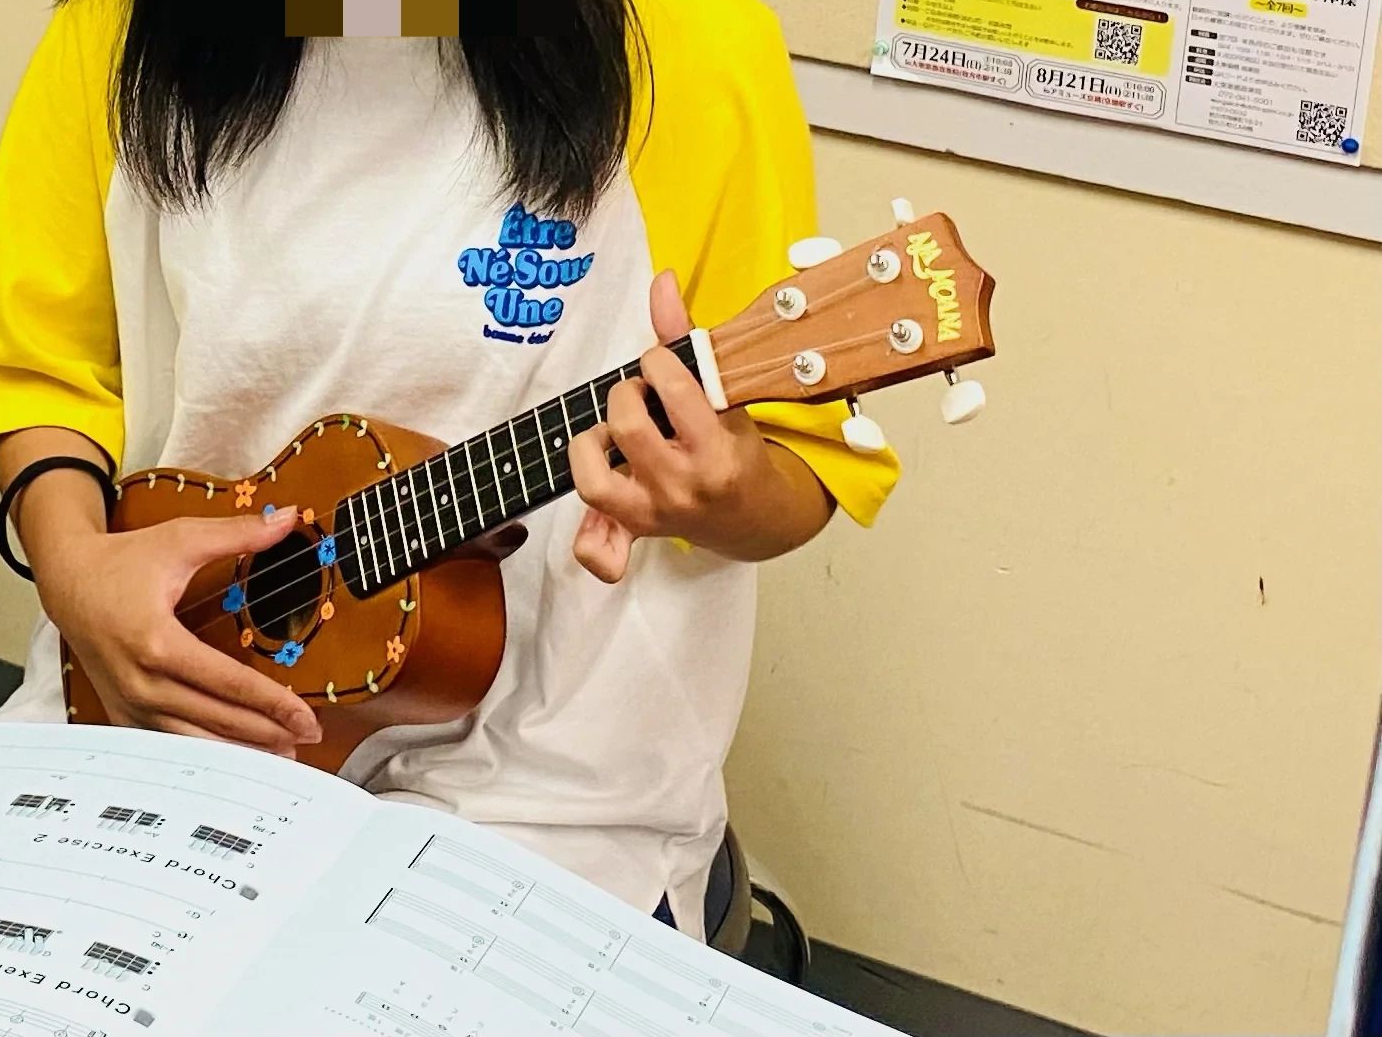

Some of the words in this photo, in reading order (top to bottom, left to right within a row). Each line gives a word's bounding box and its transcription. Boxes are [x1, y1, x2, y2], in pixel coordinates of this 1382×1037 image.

[458, 247, 514, 287] Né
[484, 286, 564, 327] Une
[34, 833, 48, 844] 2
[58, 836, 157, 863] Exercise
[165, 858, 237, 891] Chord
[55, 980, 132, 1016] Chord
